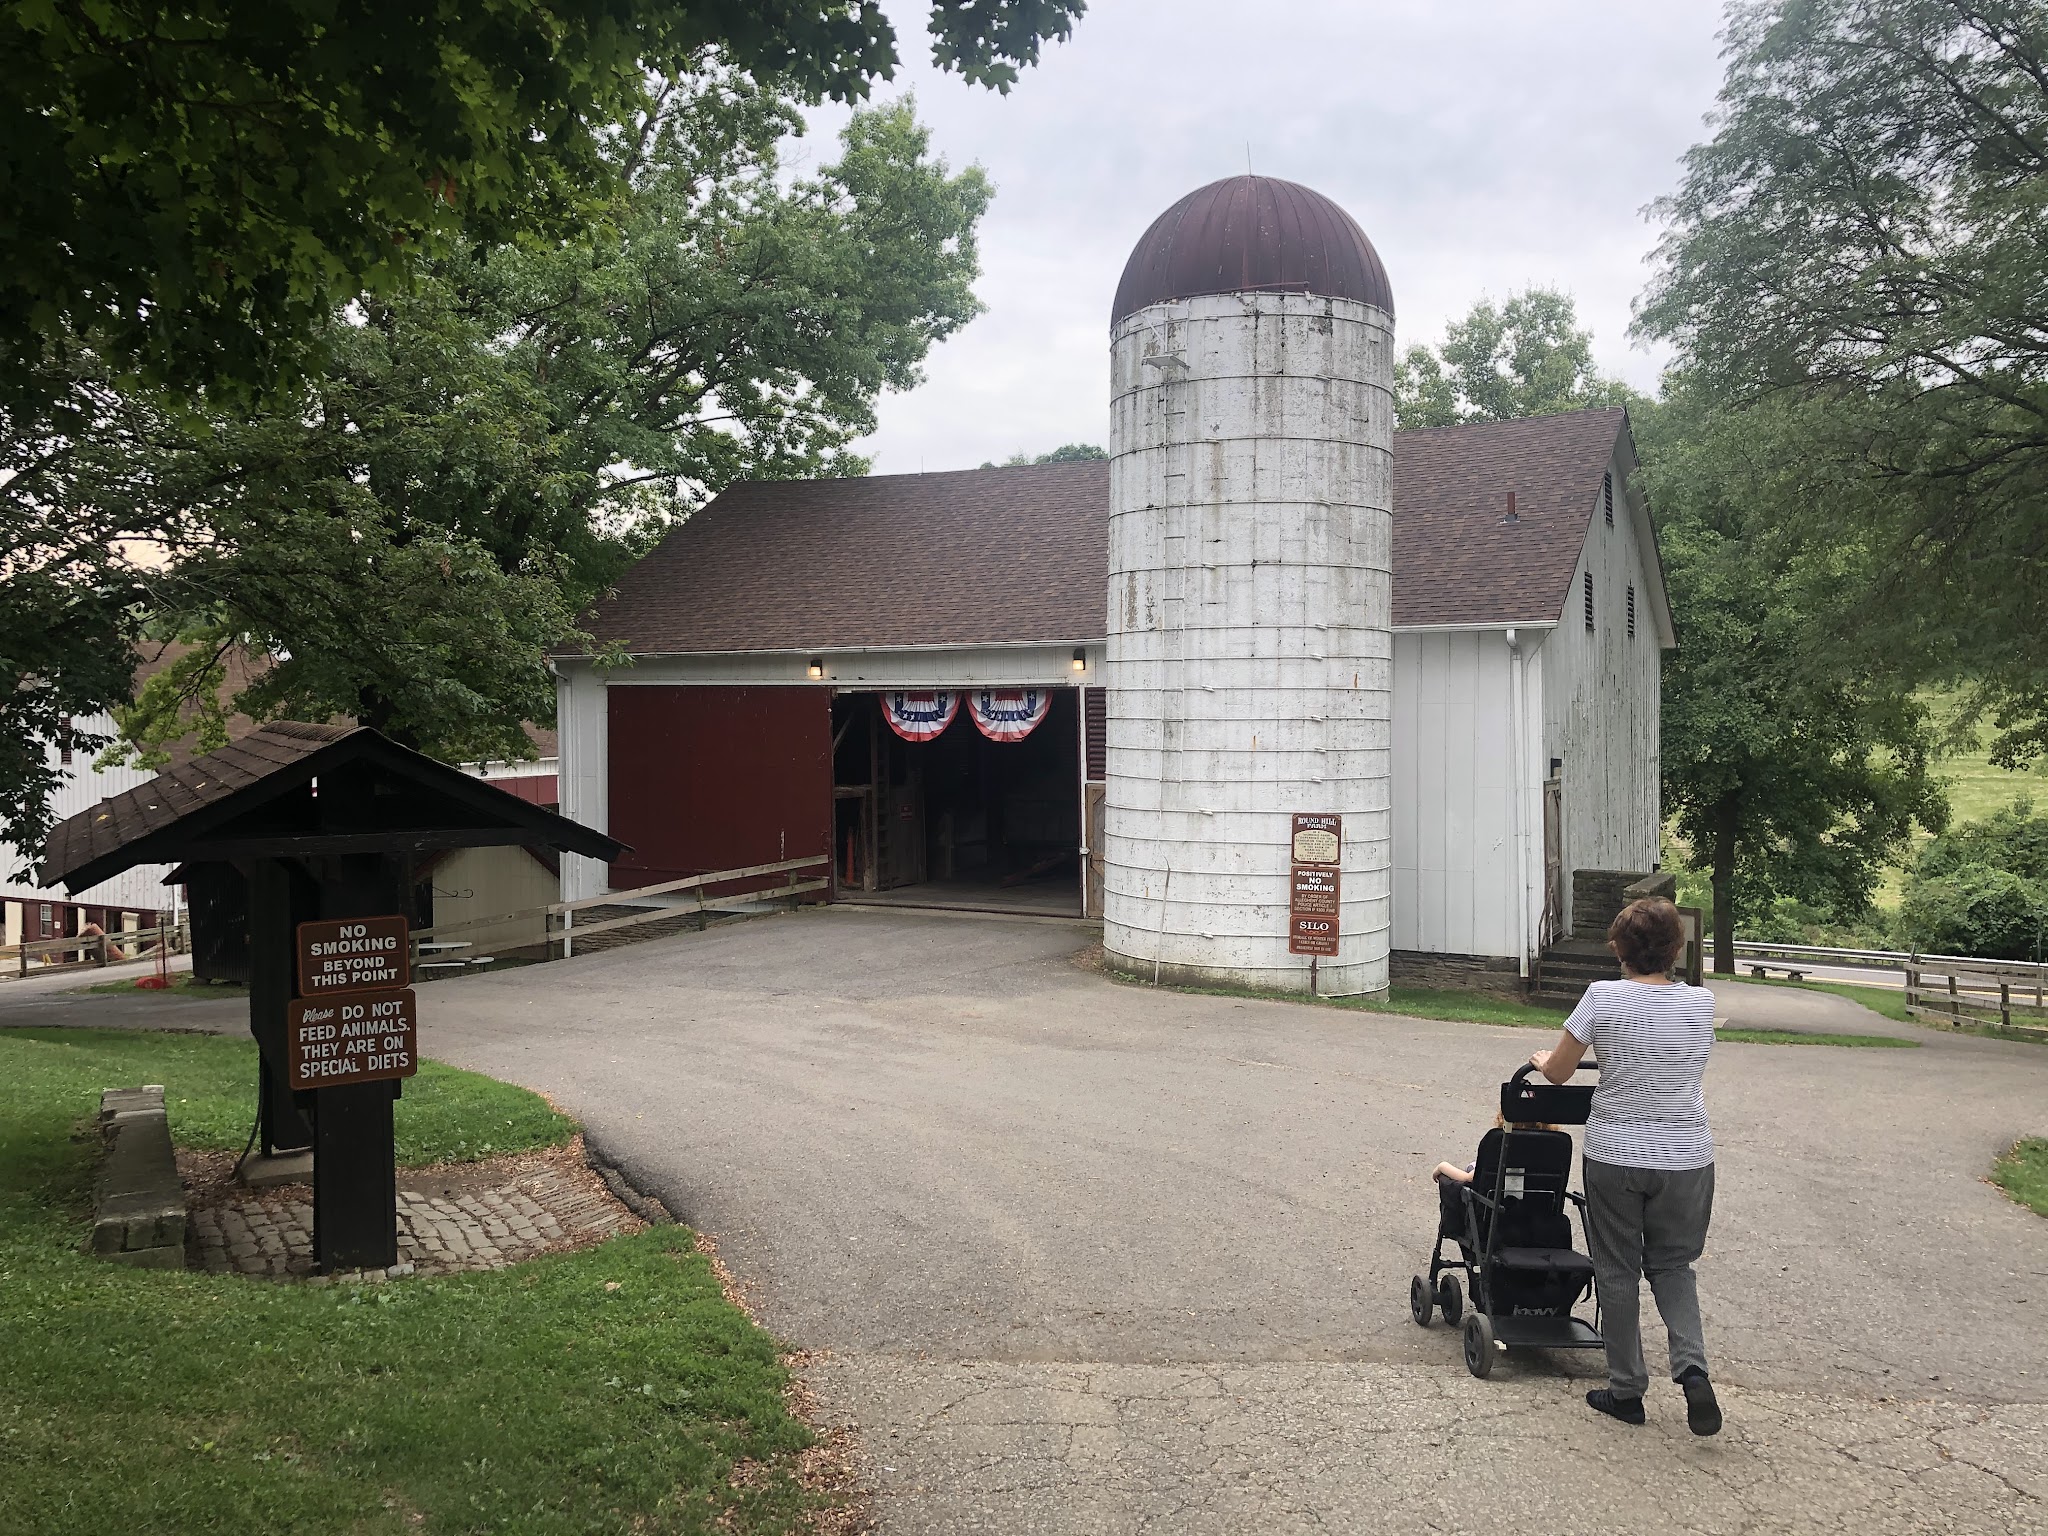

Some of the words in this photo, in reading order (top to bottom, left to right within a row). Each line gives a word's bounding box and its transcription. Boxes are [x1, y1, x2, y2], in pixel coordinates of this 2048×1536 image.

[1322, 818, 1338, 826] HILL
[1296, 884, 1335, 892] SMOKING
[340, 924, 366, 938] NO
[1300, 921, 1329, 930] SILO
[310, 936, 396, 956] SMOKING
[324, 956, 384, 972] BEYOND
[312, 973, 347, 987] THIS
[352, 968, 398, 983] POINT
[302, 1008, 334, 1024] Please
[342, 1005, 364, 1020] DO
[372, 1001, 403, 1018] NOT
[299, 1025, 336, 1042] FEED
[341, 1018, 410, 1038] ANIMALS.
[301, 1042, 340, 1060] THEY
[345, 1038, 376, 1055] ARE
[384, 1035, 404, 1050] ON
[300, 1058, 360, 1079] SPECIAL
[368, 1052, 409, 1071] DIETS
